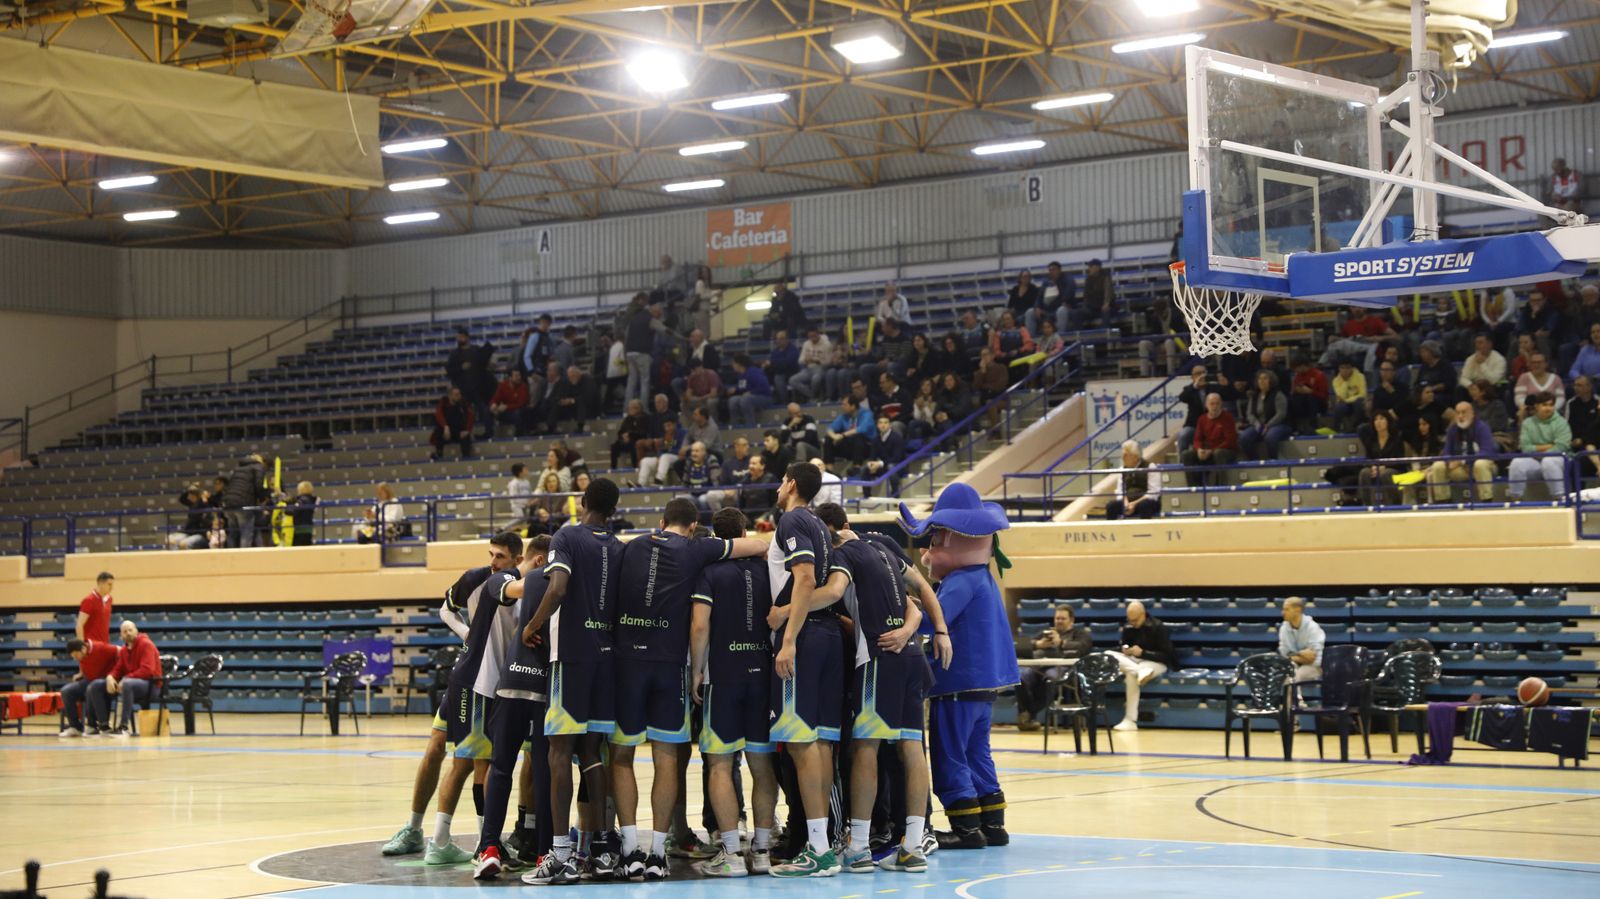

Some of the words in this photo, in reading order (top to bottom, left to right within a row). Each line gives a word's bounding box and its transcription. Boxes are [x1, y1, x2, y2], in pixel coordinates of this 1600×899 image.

[1029, 177, 1041, 202] B
[734, 208, 765, 226] Bar
[540, 231, 550, 252] A
[711, 224, 788, 250] Cafetería
[1064, 532, 1117, 543] PRENSA
[1165, 530, 1183, 541] TV
[458, 687, 469, 724] damex
